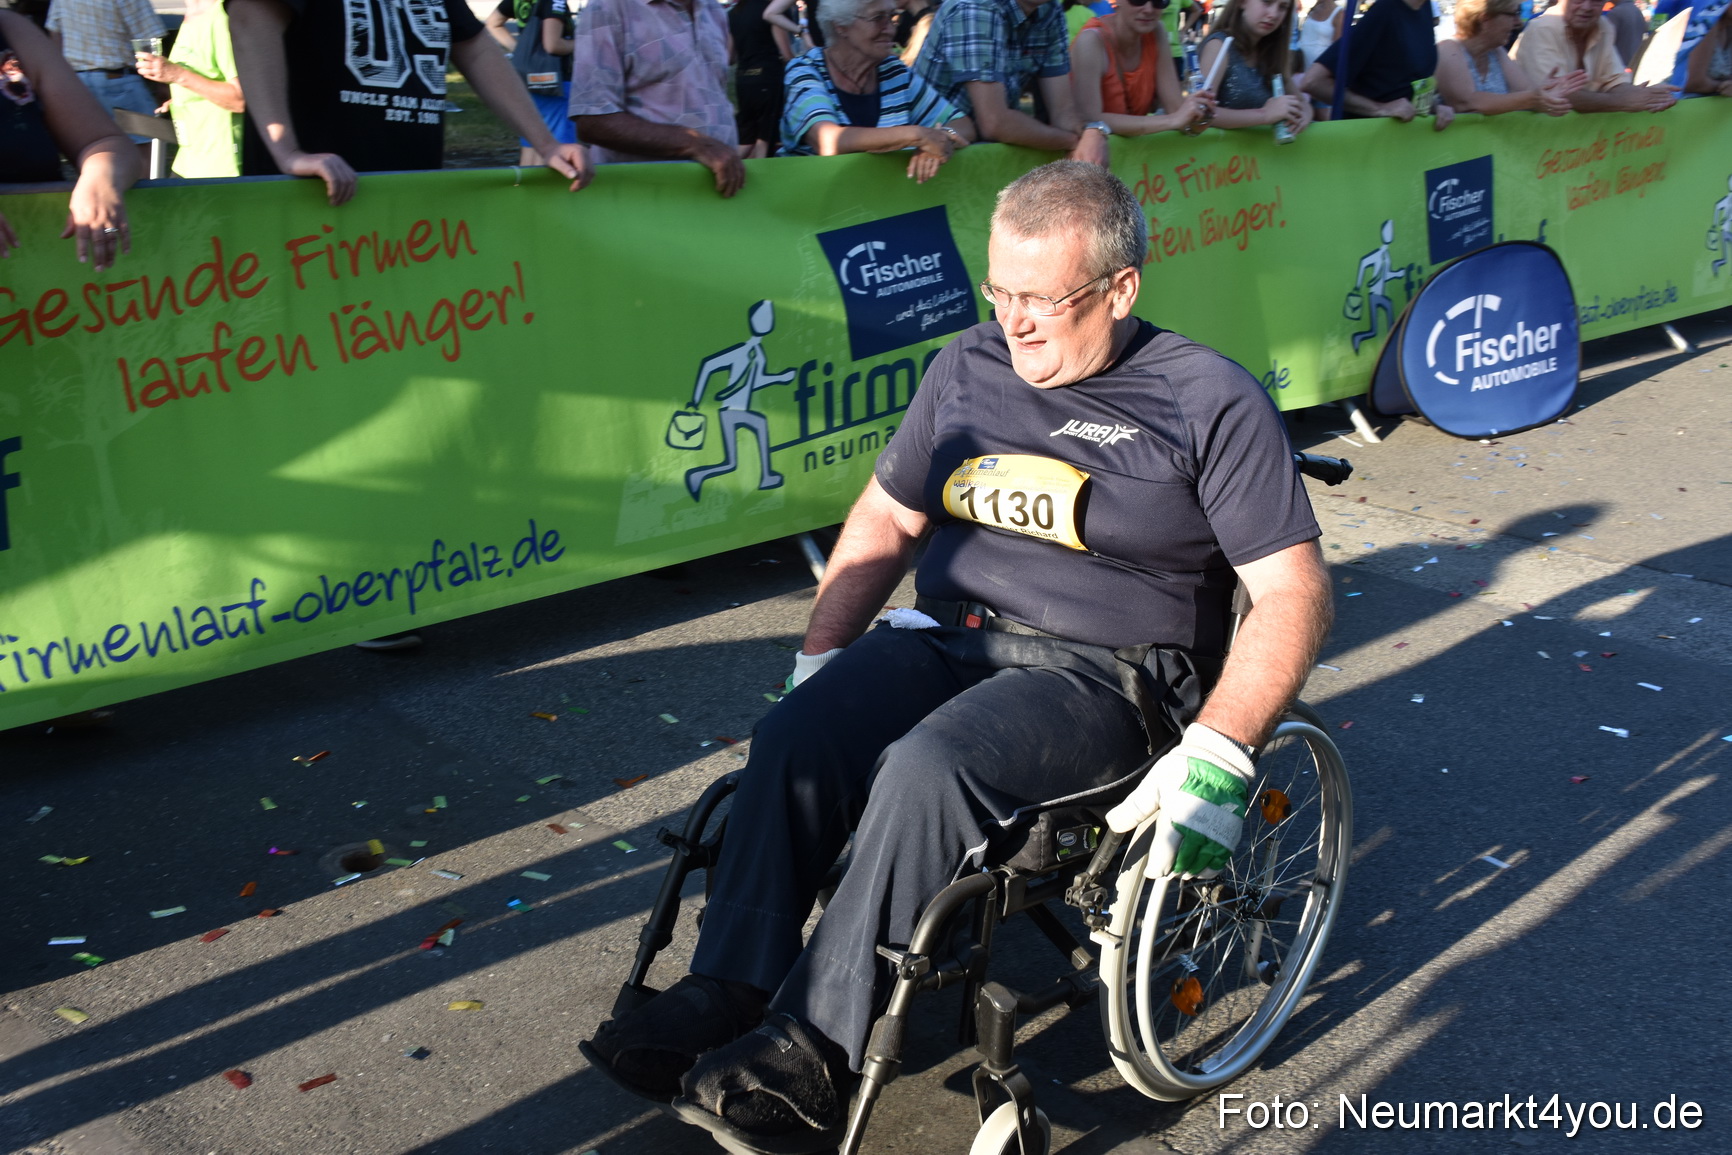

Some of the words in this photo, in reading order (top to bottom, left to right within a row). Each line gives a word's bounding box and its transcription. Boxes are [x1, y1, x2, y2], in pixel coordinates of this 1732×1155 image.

[340, 90, 389, 106] UNCLE
[392, 95, 419, 109] SAM
[1174, 155, 1261, 198] Firmen
[1199, 186, 1286, 251] länger!
[1440, 190, 1486, 213] Fischer
[285, 218, 478, 289] Firmen
[860, 252, 943, 287] Fischer
[876, 272, 945, 298] AUTOMOBILE
[118, 321, 318, 413] laufen
[329, 261, 535, 364] länger!
[1455, 321, 1562, 372] Fischer
[1470, 357, 1558, 392] AUTOMOBILE
[960, 487, 1054, 530] 1130
[1020, 527, 1059, 539] Richard
